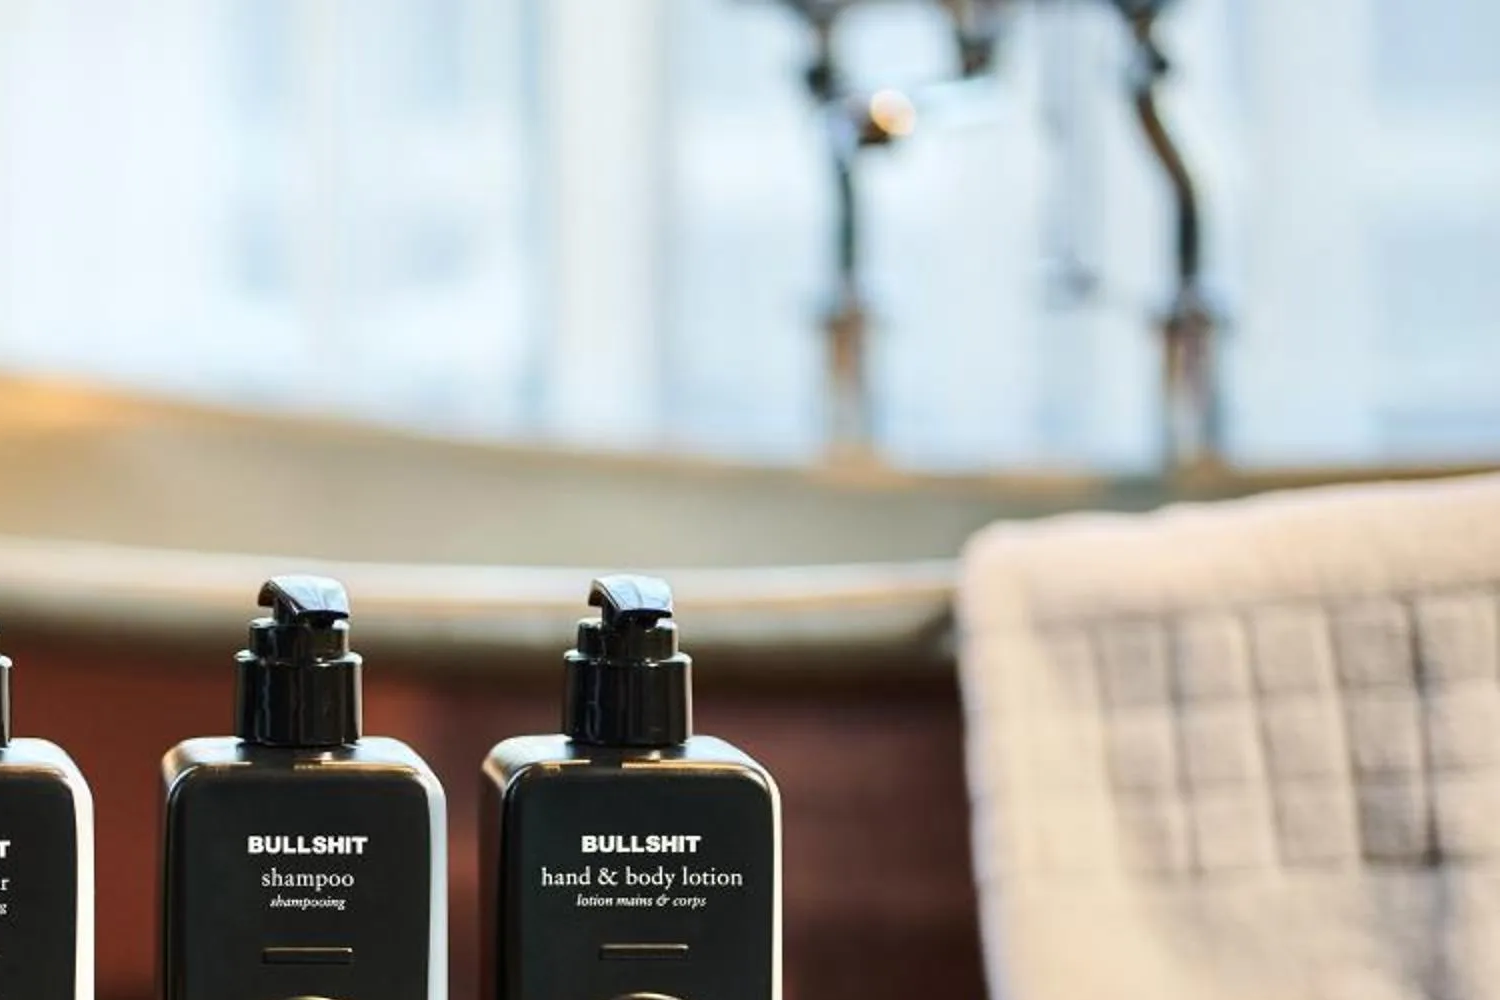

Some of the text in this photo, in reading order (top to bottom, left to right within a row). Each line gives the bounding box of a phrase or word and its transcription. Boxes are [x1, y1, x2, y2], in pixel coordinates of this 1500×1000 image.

[248, 836, 368, 854] BULLSHIT
[581, 835, 702, 853] BULLSHIT
[262, 867, 354, 892] shampoo
[542, 866, 742, 890] hand & body lotion
[270, 894, 346, 910] shampooing
[577, 893, 706, 909] lotion mains & corps
